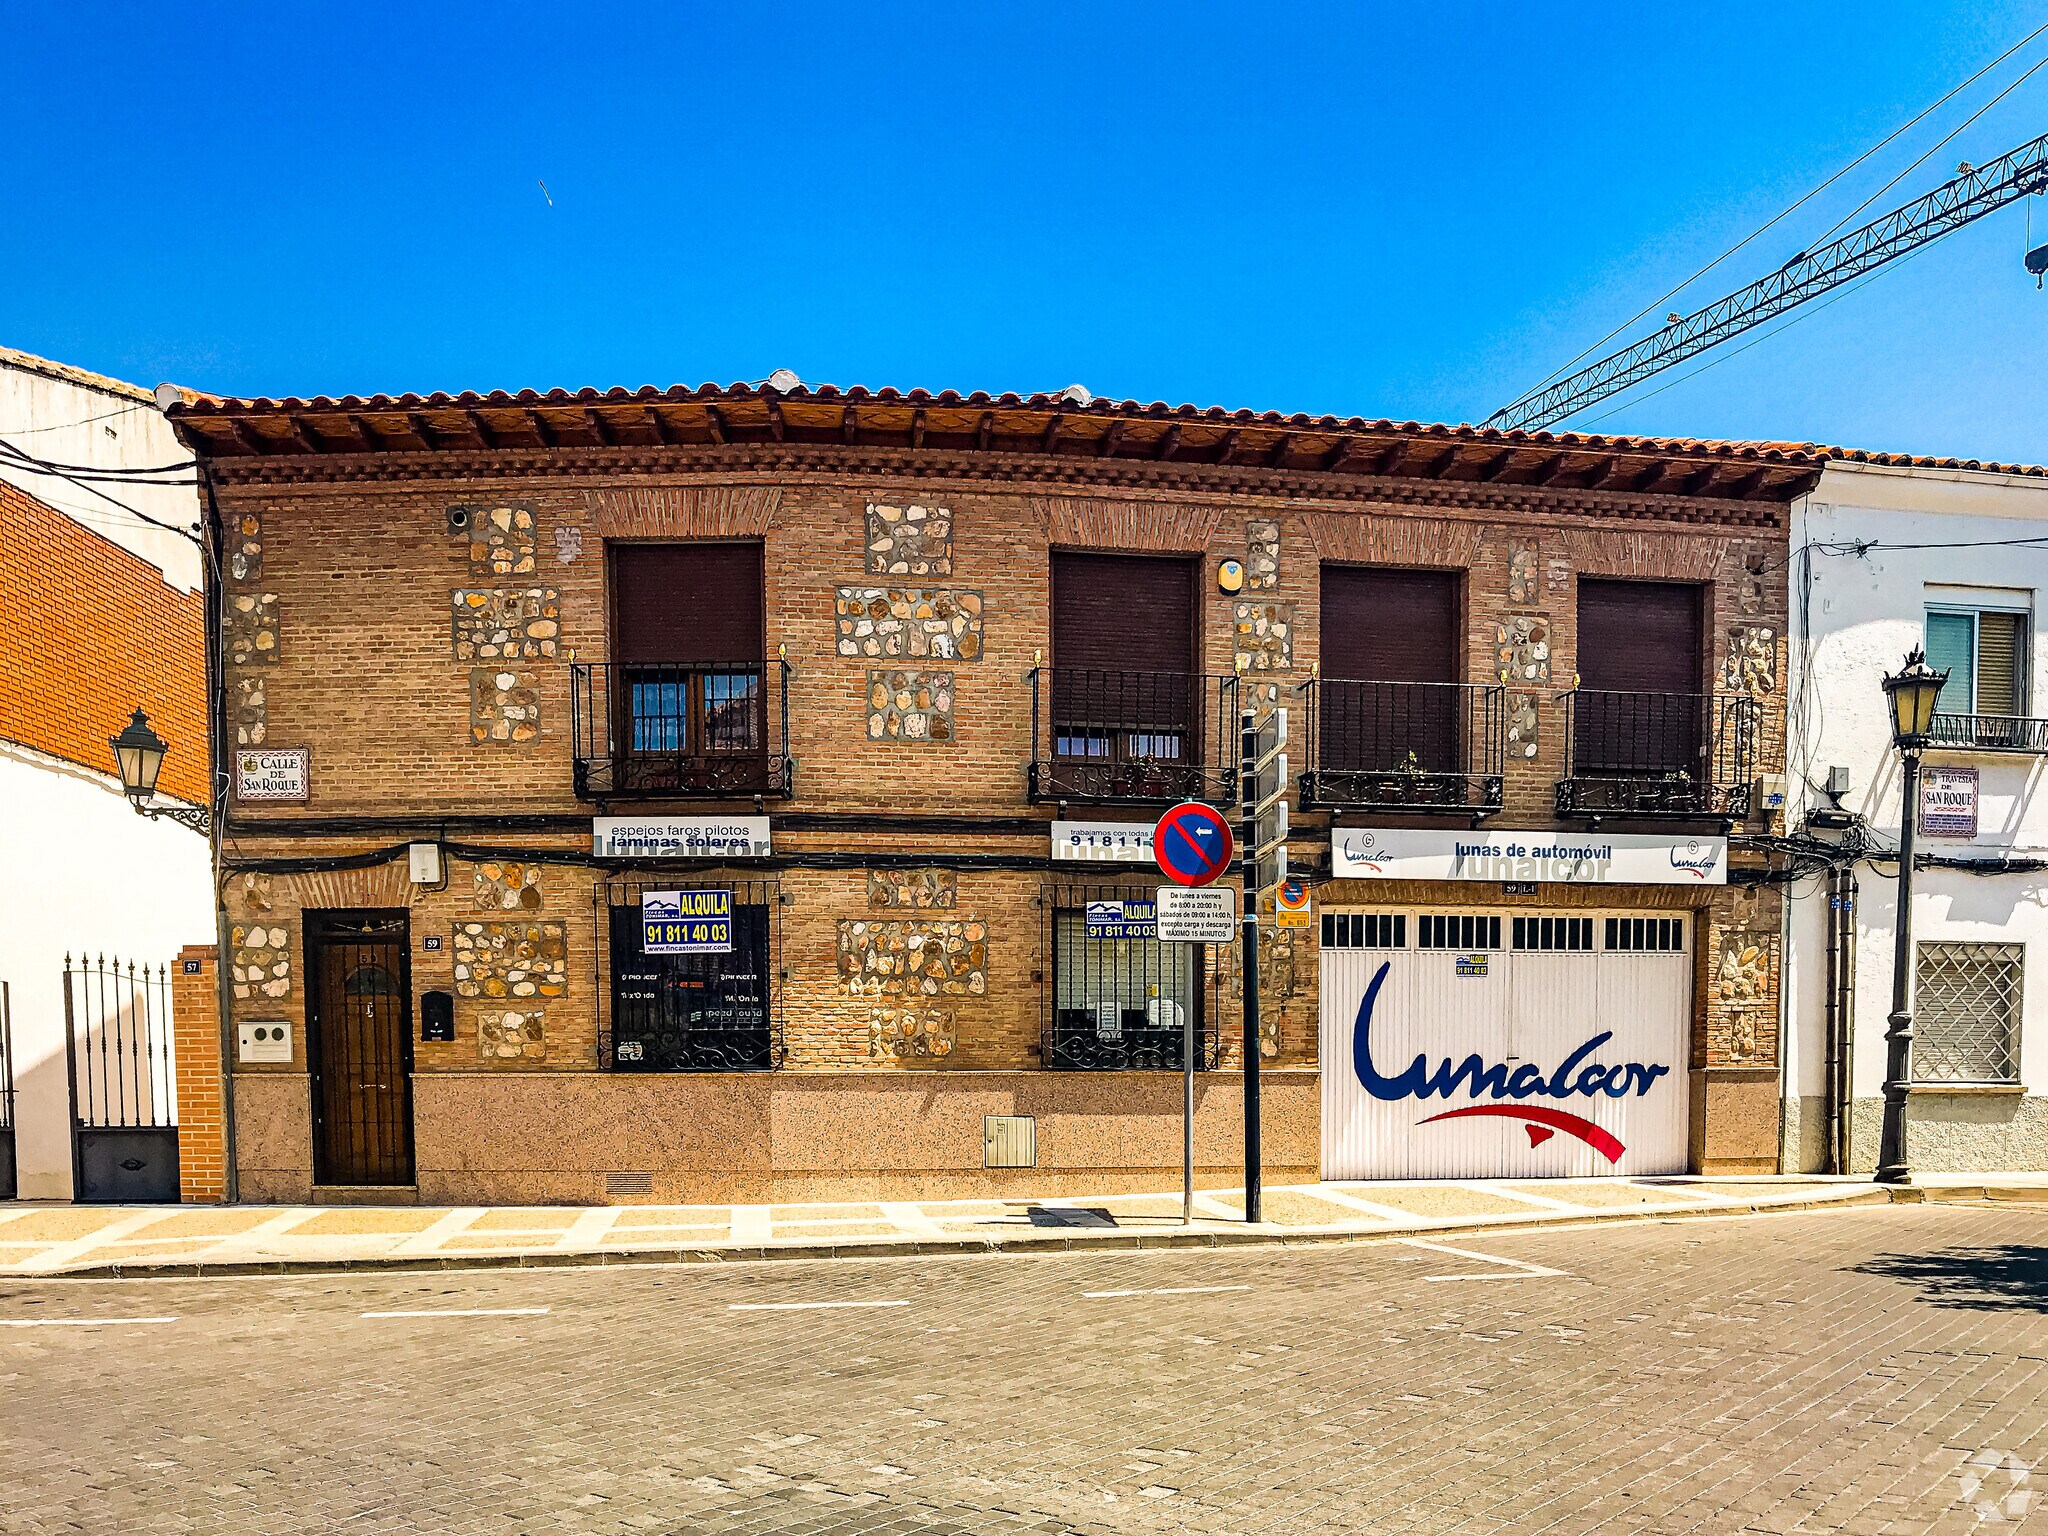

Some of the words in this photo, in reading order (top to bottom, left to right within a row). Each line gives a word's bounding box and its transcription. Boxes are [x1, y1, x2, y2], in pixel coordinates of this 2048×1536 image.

[262, 778, 298, 791] ROQUE
[1926, 791, 1942, 804] SAN
[1943, 793, 1972, 806] ROQUE
[611, 825, 663, 837] espejos
[668, 825, 700, 836] faros
[705, 825, 749, 837] pilotos
[1070, 829, 1111, 837] trabajamos
[611, 836, 680, 847] láminas
[686, 836, 749, 847] solares
[1456, 842, 1500, 857] lunas
[1506, 843, 1526, 857] de
[1532, 844, 1611, 860] automóvil
[681, 894, 728, 916] ALQUILA
[1124, 905, 1156, 919] ALQUILA
[1089, 926, 1102, 937] 91
[1105, 926, 1122, 936] 811
[1126, 926, 1140, 936] 40
[1142, 925, 1156, 936] 03
[1161, 921, 1183, 929] excepto
[1206, 921, 1231, 929] descarga
[647, 925, 662, 942] 91
[666, 925, 688, 942] 811
[692, 924, 708, 941] 40
[711, 924, 727, 941] 03
[1166, 928, 1190, 937] MÁXIMO
[427, 939, 438, 948] 59
[187, 963, 197, 971] 57
